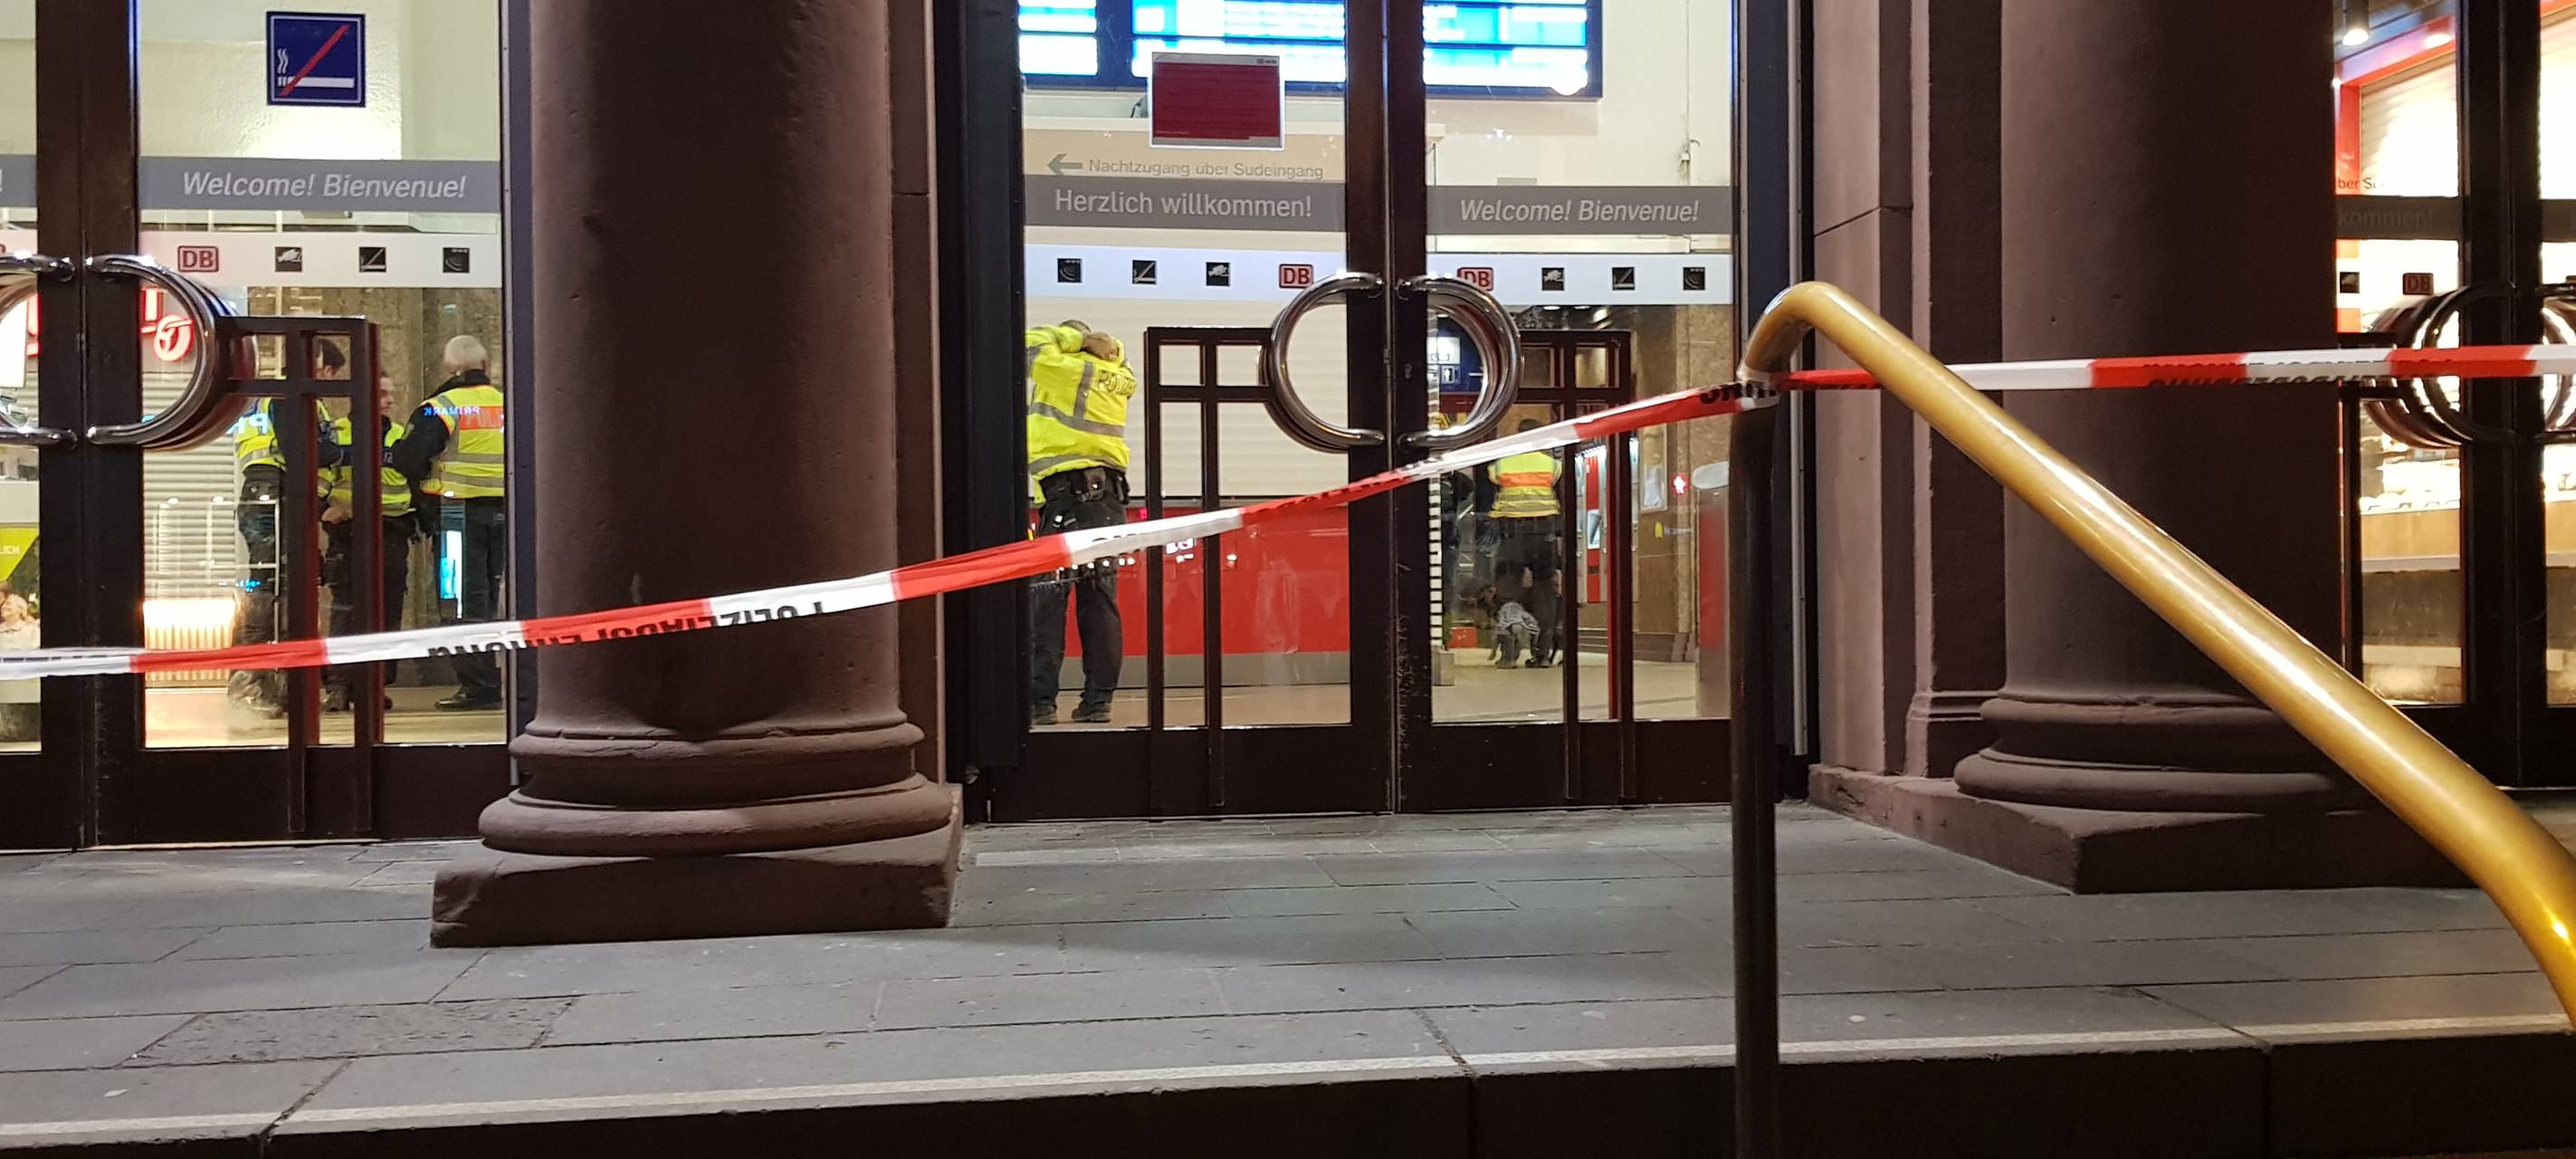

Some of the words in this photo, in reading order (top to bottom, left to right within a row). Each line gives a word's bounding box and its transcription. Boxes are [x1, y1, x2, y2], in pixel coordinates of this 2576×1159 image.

[1089, 159, 1190, 177] Nachtzugang
[183, 170, 316, 196] Welcome!
[321, 173, 467, 198] Bienvenue!
[1055, 188, 1152, 215] Herzlich
[1161, 192, 1312, 218] willkommen!
[1460, 199, 1570, 223] Welcome!
[1579, 199, 1700, 223] Bienvenue!
[181, 249, 215, 269] DB
[1282, 265, 1312, 285] DB
[2407, 274, 2431, 292] DB
